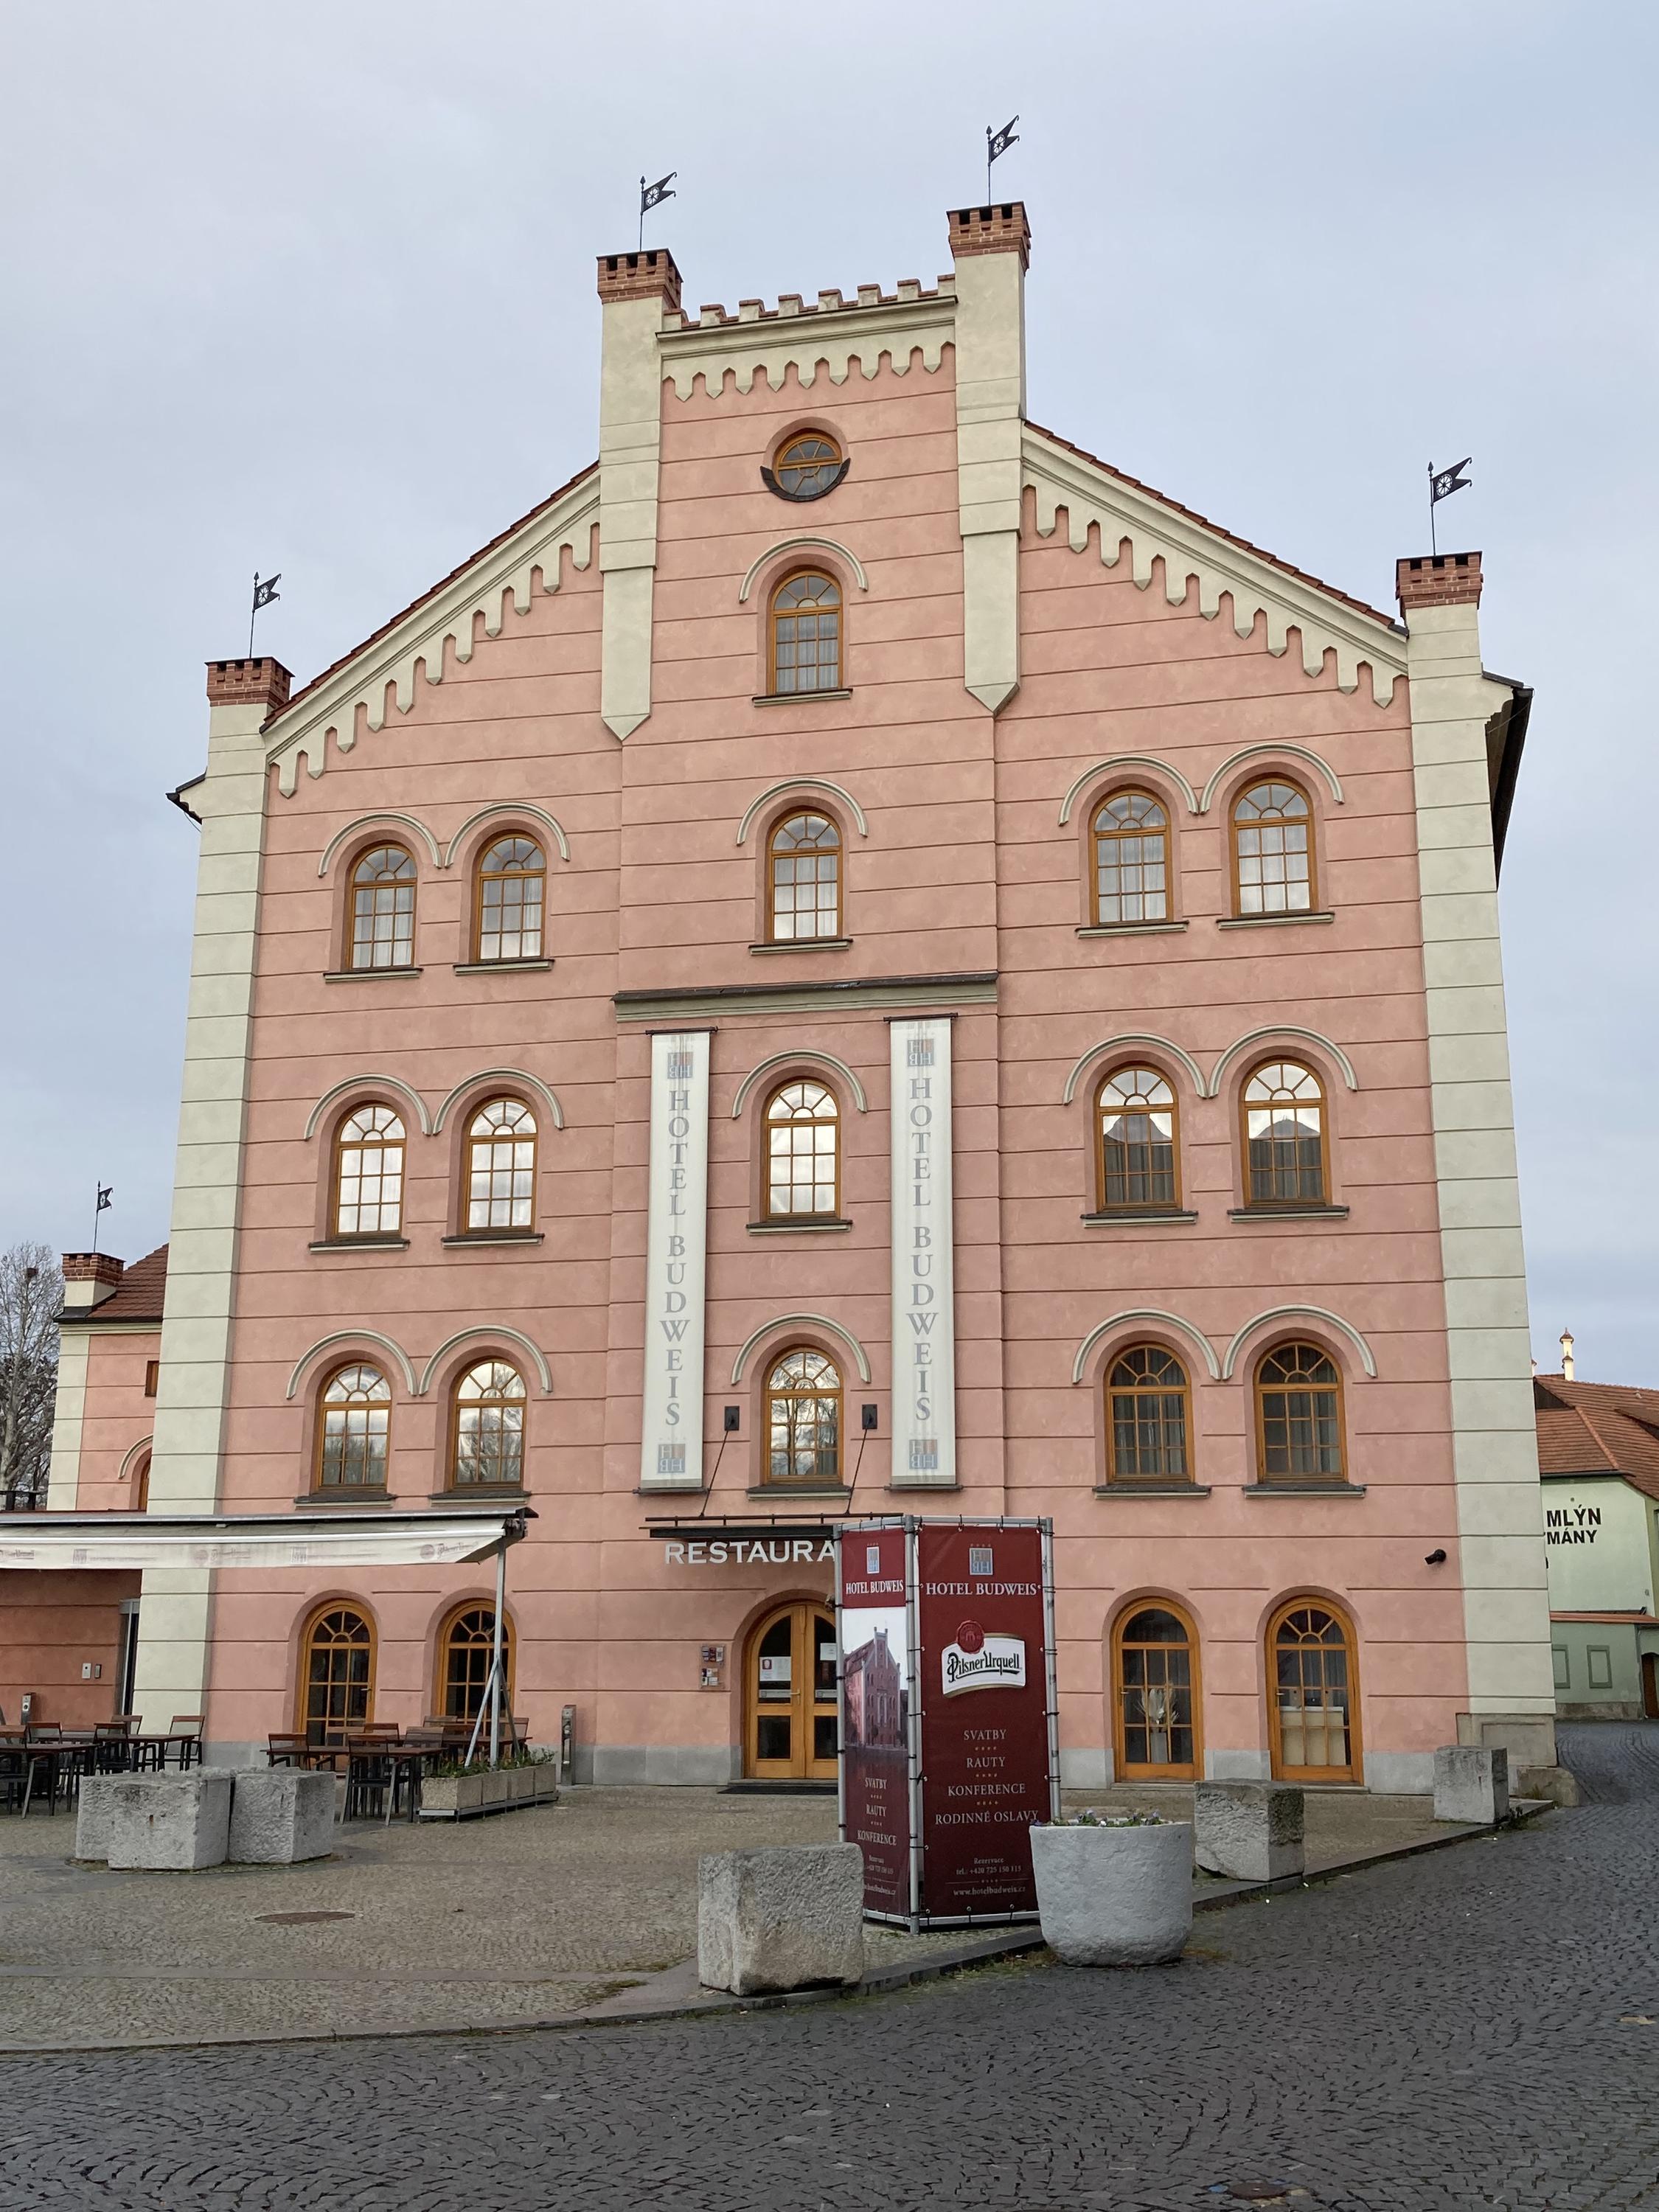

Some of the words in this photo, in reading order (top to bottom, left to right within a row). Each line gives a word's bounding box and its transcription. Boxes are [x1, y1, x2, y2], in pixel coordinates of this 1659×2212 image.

[909, 1077, 932, 1206] HOTEL
[668, 1090, 690, 1216] HOTEL
[659, 1235, 690, 1426] BUDWEIS
[905, 1225, 939, 1421] BUDWEIS
[1546, 1504, 1601, 1527] MLÝN
[1544, 1527, 1597, 1545] MÁNY
[846, 1582, 869, 1595] HOTEL
[870, 1579, 904, 1593] BUDWEIS
[925, 1583, 973, 1596] HOTEL
[975, 1582, 1037, 1596] BUDWEIS
[947, 1652, 985, 1683] Pilsner
[983, 1650, 1020, 1676] Urquell
[964, 1729, 1006, 1740] SVATBY
[966, 1756, 1006, 1768] RAUTY
[865, 1777, 888, 1790] SVATBY
[947, 1783, 1026, 1796] KONFERENCE
[866, 1804, 887, 1817] RAUTY
[935, 1810, 991, 1825] RODINNÉ
[994, 1810, 1038, 1822] OSLAVY
[857, 1829, 897, 1846] KONFERENCE
